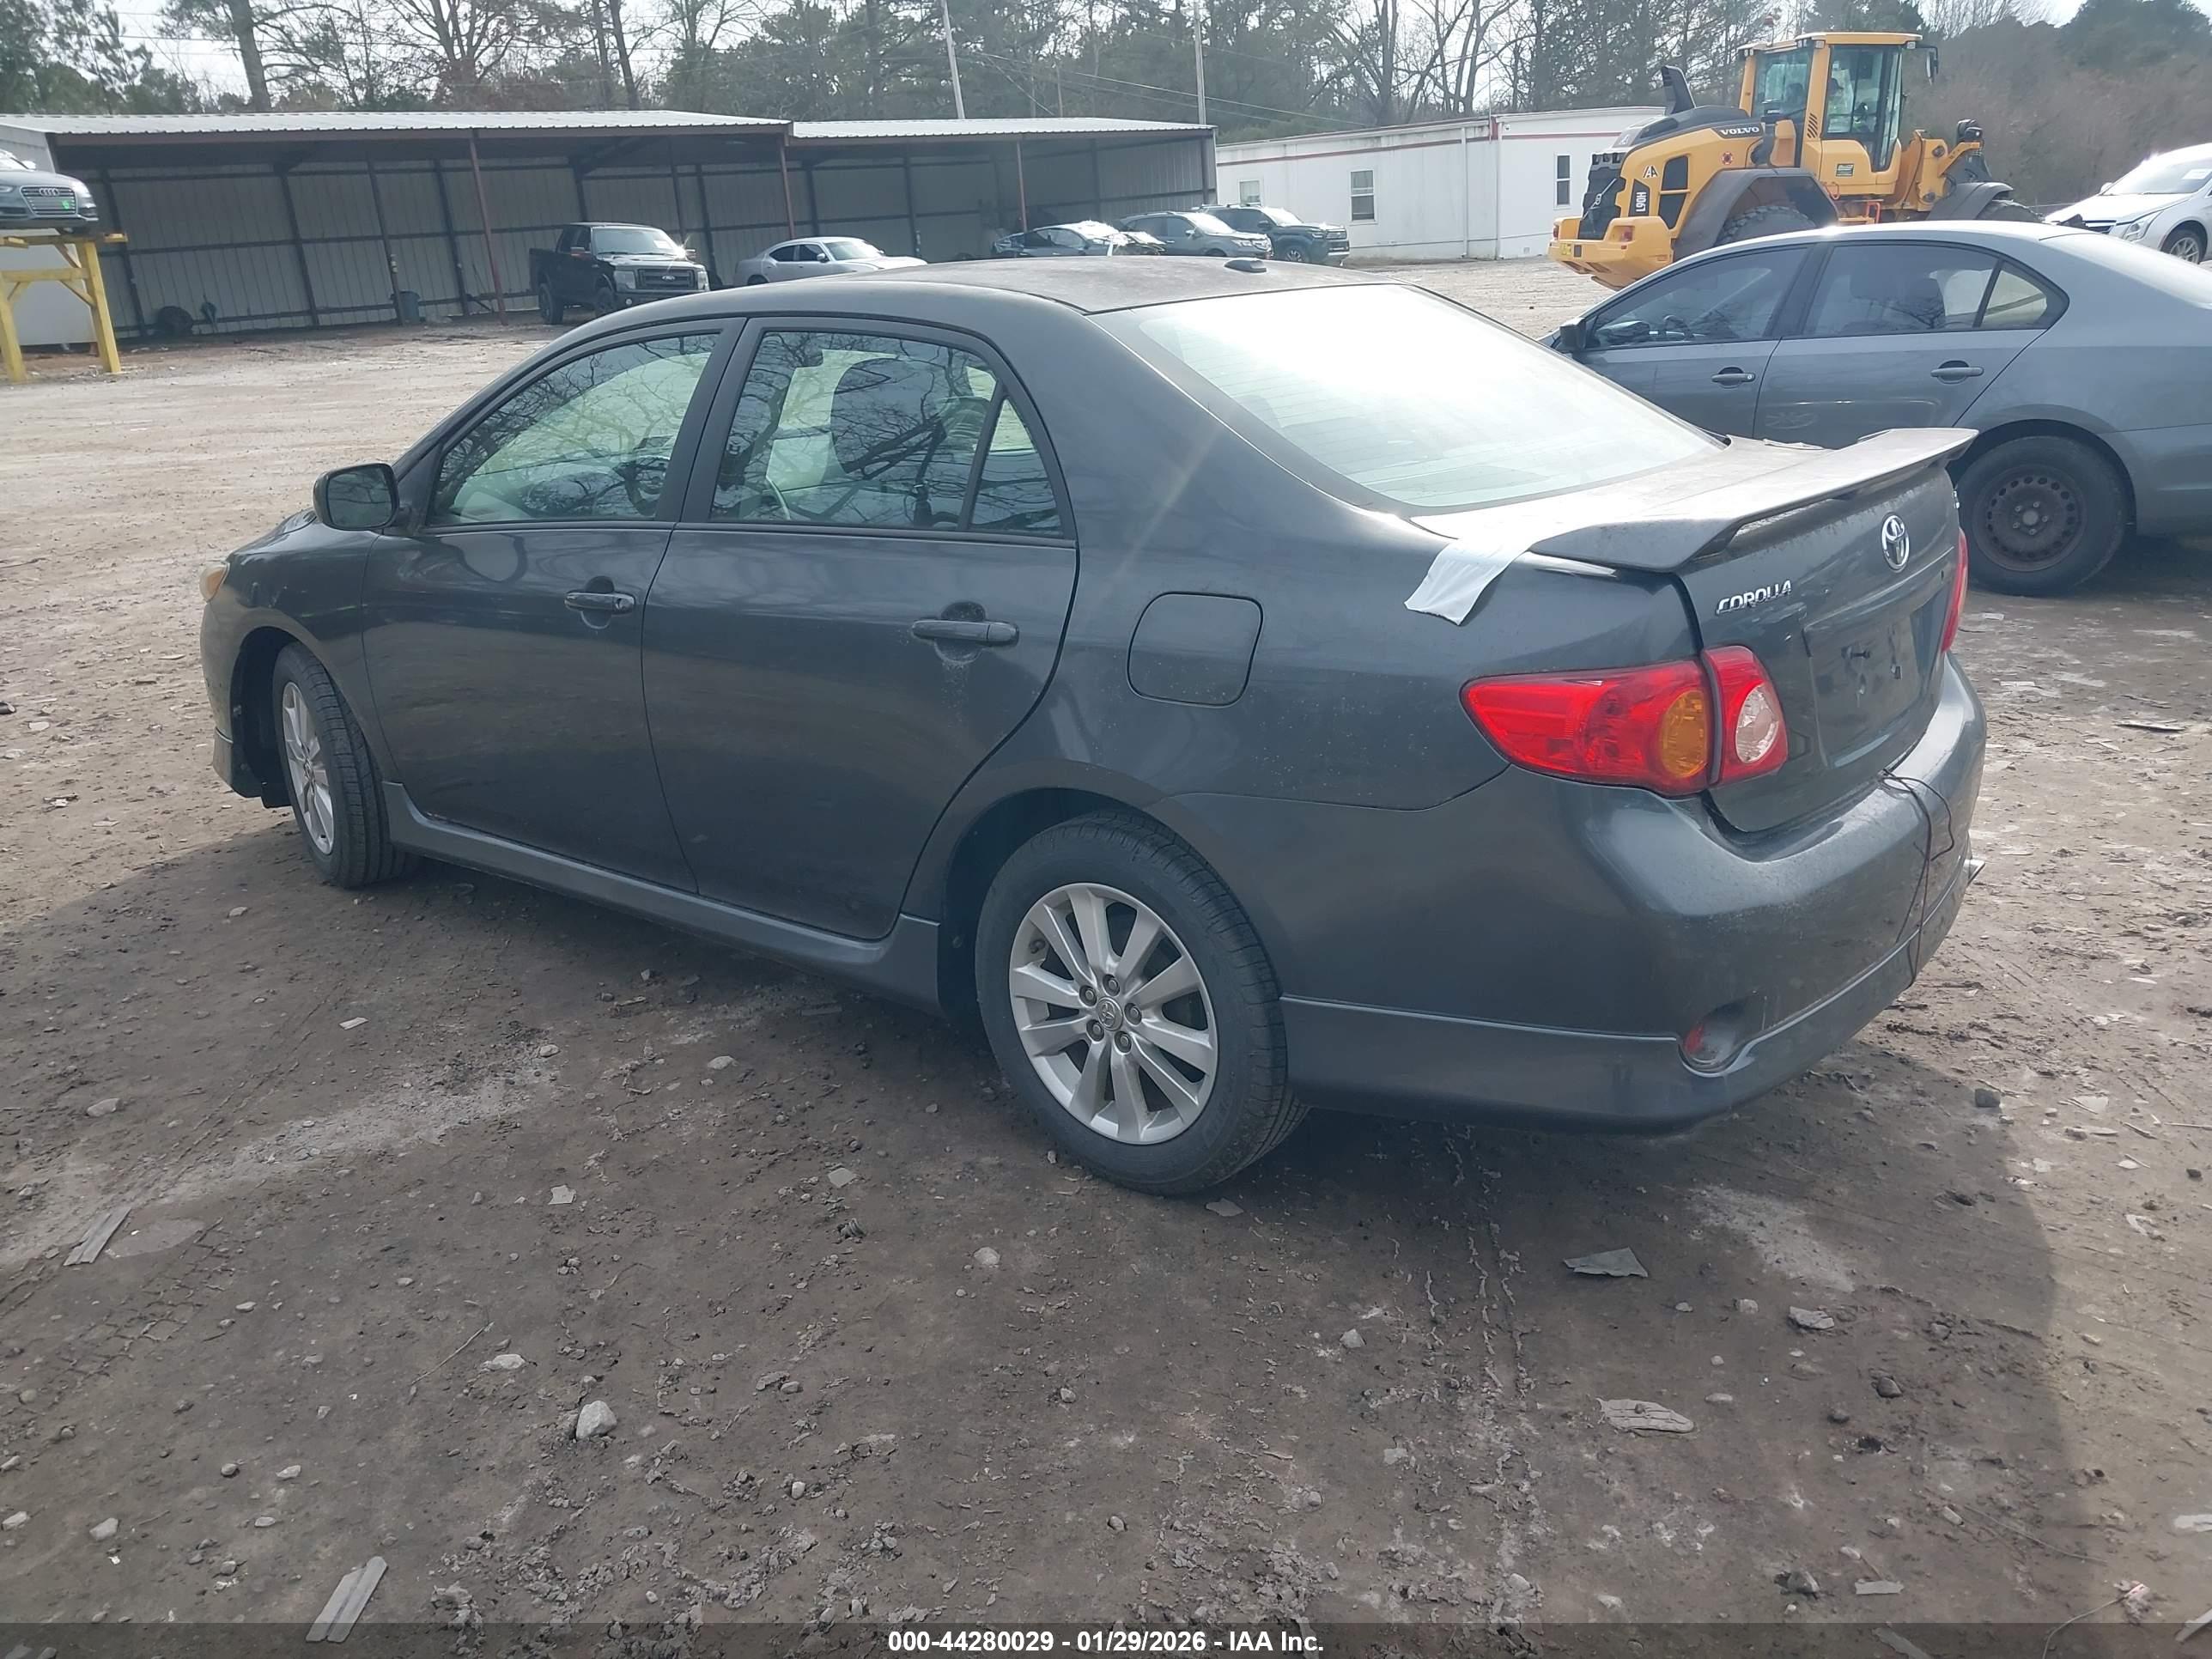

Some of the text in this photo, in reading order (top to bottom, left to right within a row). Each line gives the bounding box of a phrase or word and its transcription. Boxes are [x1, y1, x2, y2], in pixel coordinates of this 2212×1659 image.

[1720, 126, 1760, 136] VOLVO
[1636, 191, 1647, 212] L90H
[1716, 580, 1792, 615] COROLLA
